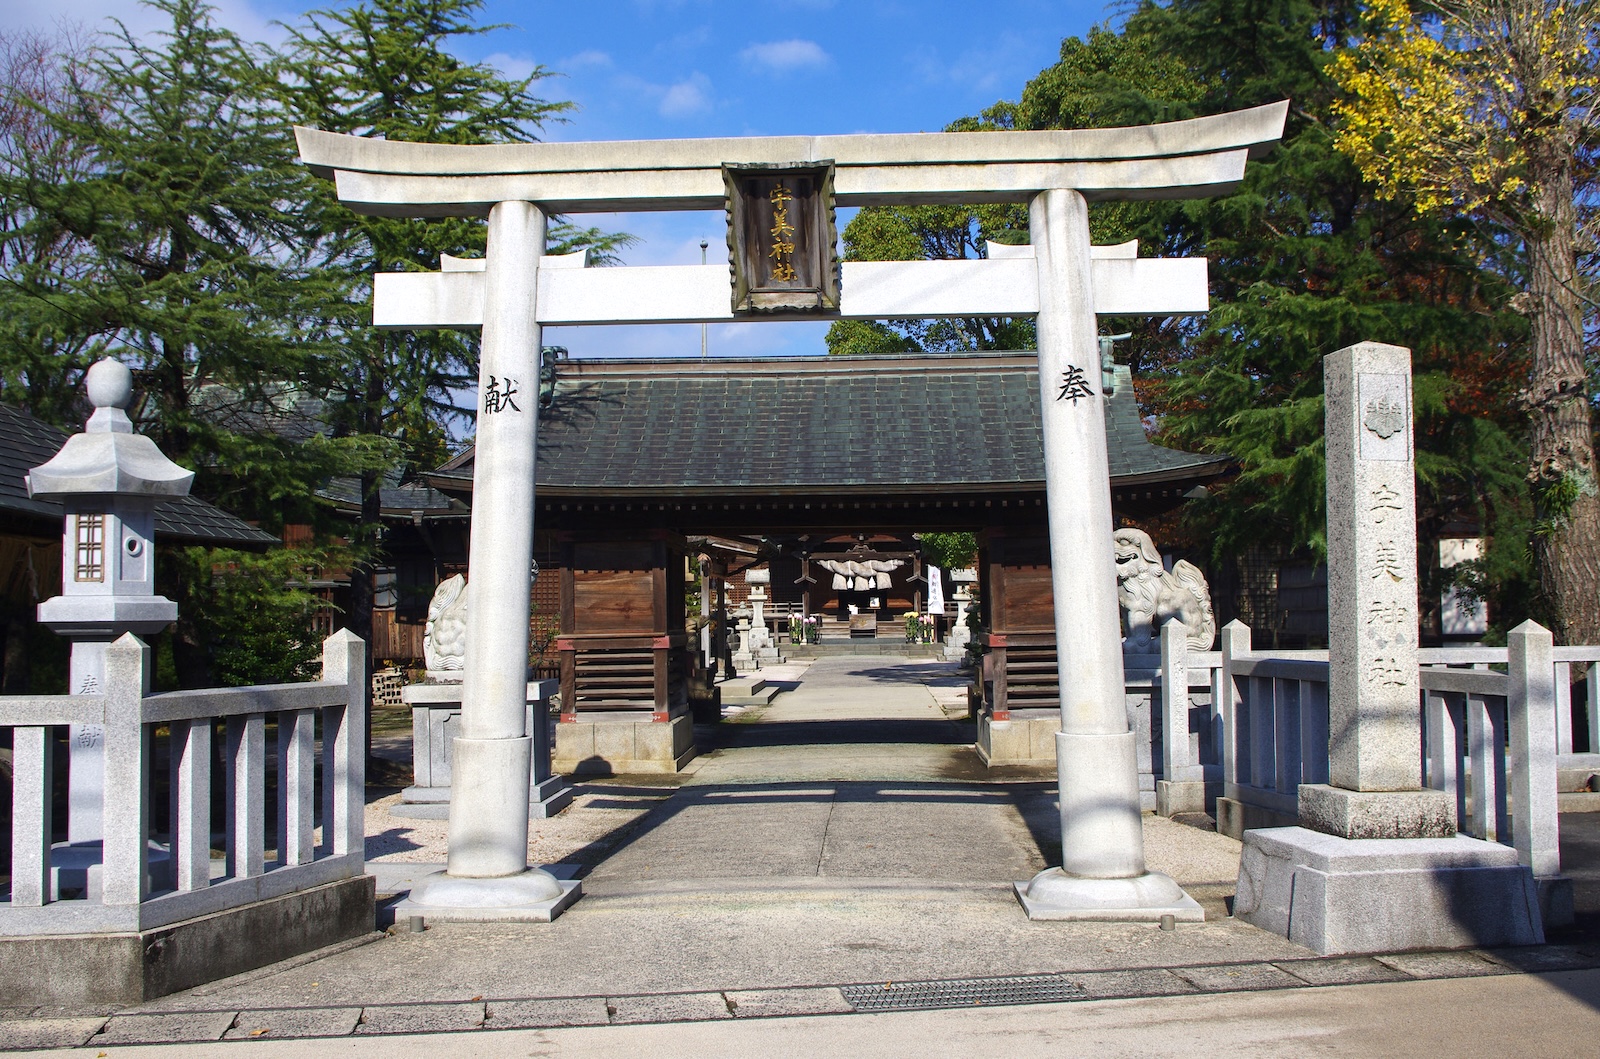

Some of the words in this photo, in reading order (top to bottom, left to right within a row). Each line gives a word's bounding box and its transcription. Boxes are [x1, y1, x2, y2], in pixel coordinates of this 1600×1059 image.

[768, 183, 798, 283] 宇美神社
[484, 375, 521, 415] 献
[1056, 364, 1095, 407] 奉
[1367, 483, 1408, 688] 宇美神社
